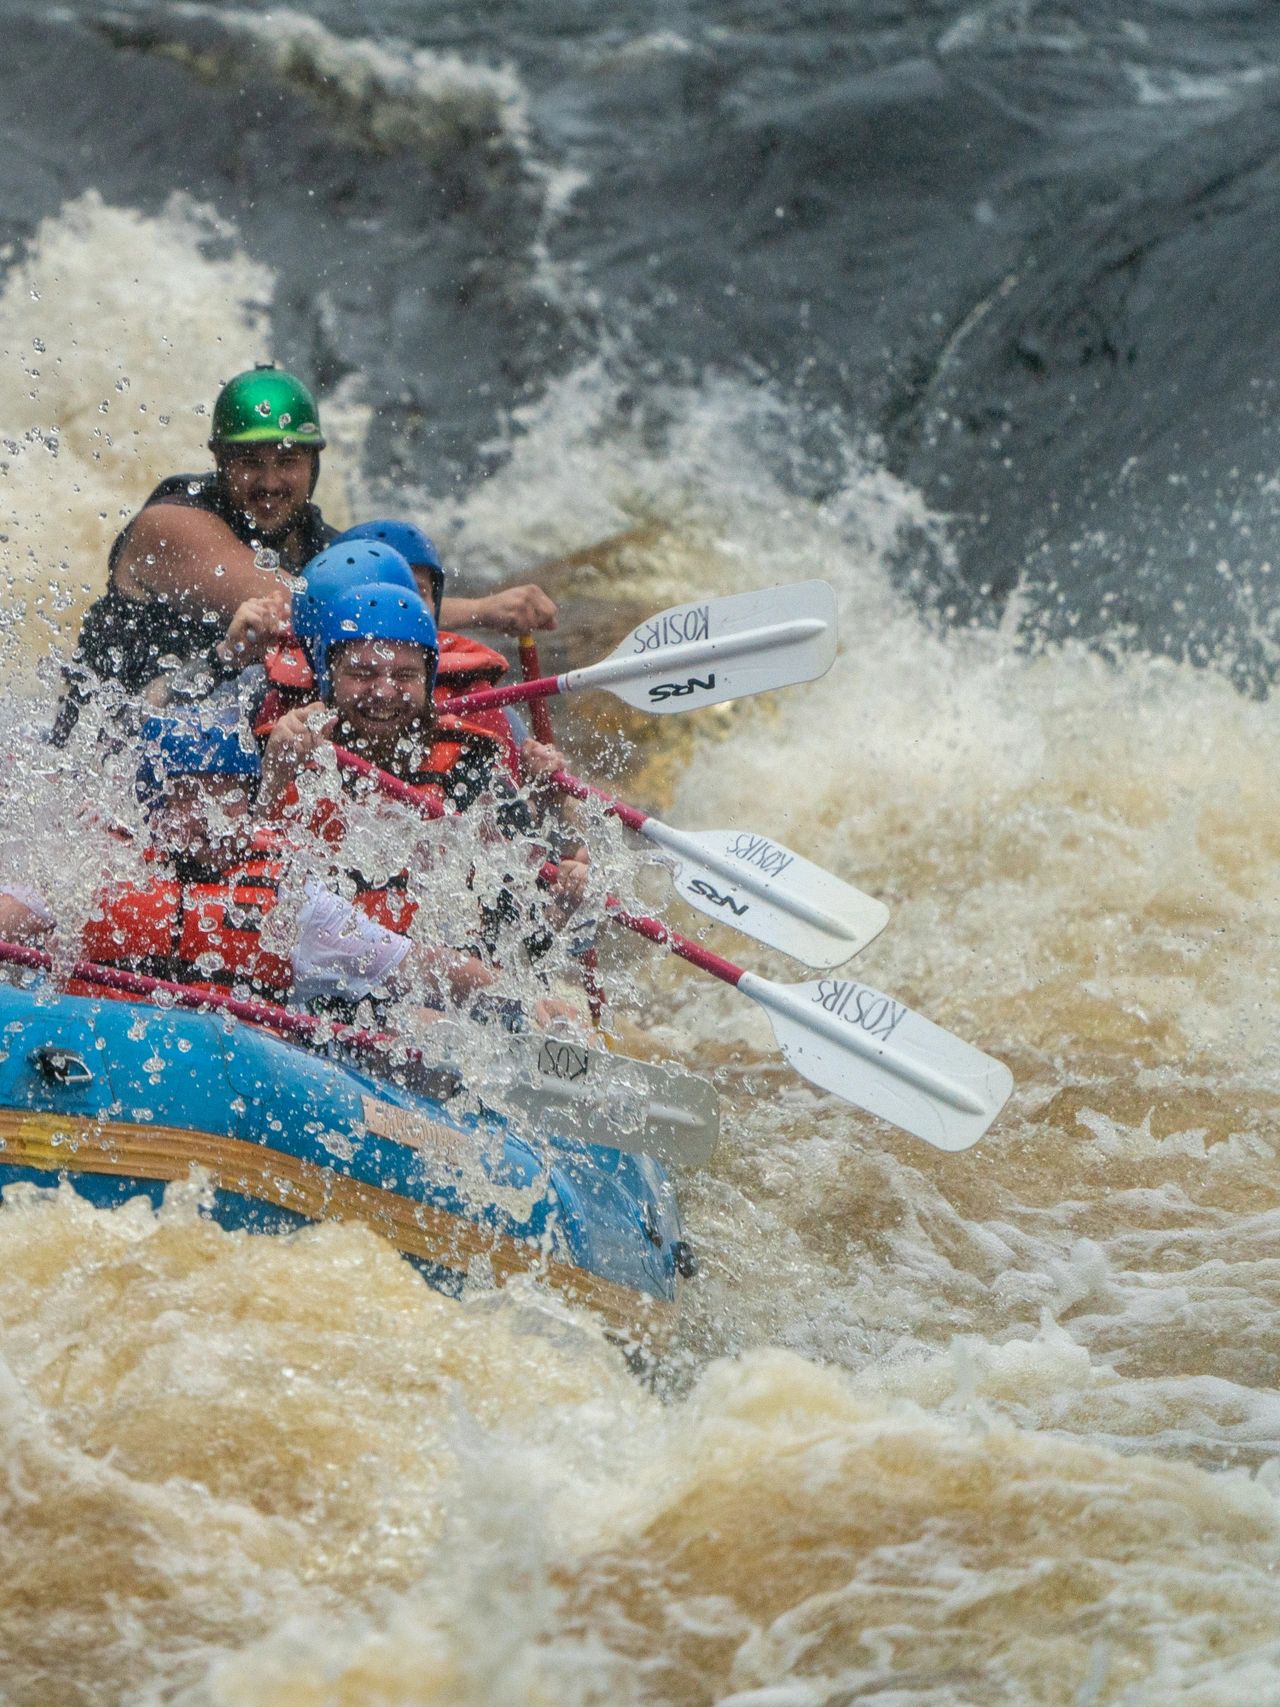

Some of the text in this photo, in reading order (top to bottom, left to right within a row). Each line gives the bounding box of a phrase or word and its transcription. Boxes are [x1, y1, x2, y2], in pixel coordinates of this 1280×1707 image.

[633, 605, 709, 654] KOSIRS
[648, 673, 716, 703] NRS
[726, 832, 795, 878] KOSIRS
[687, 879, 750, 917] NRS
[811, 979, 908, 1042] KOSIRS
